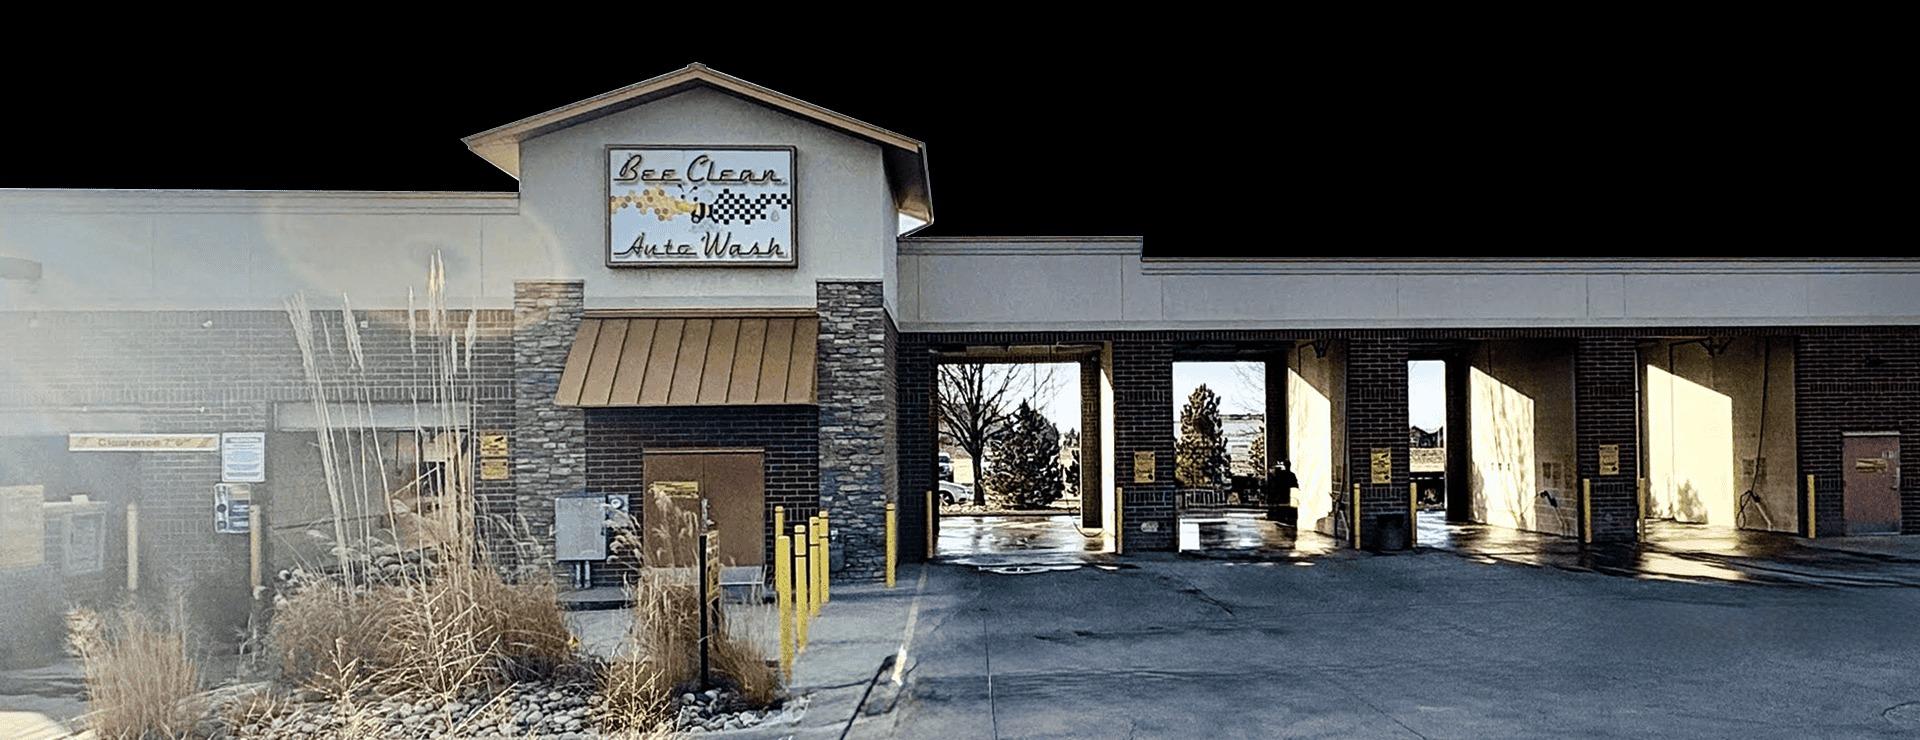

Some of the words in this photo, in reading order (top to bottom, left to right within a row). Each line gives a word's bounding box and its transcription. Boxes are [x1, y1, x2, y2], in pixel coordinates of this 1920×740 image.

[614, 154, 682, 183] Bee
[687, 154, 781, 183] Clean
[614, 232, 697, 255] Auto
[700, 231, 783, 256] Wash
[98, 438, 161, 448] Clearance
